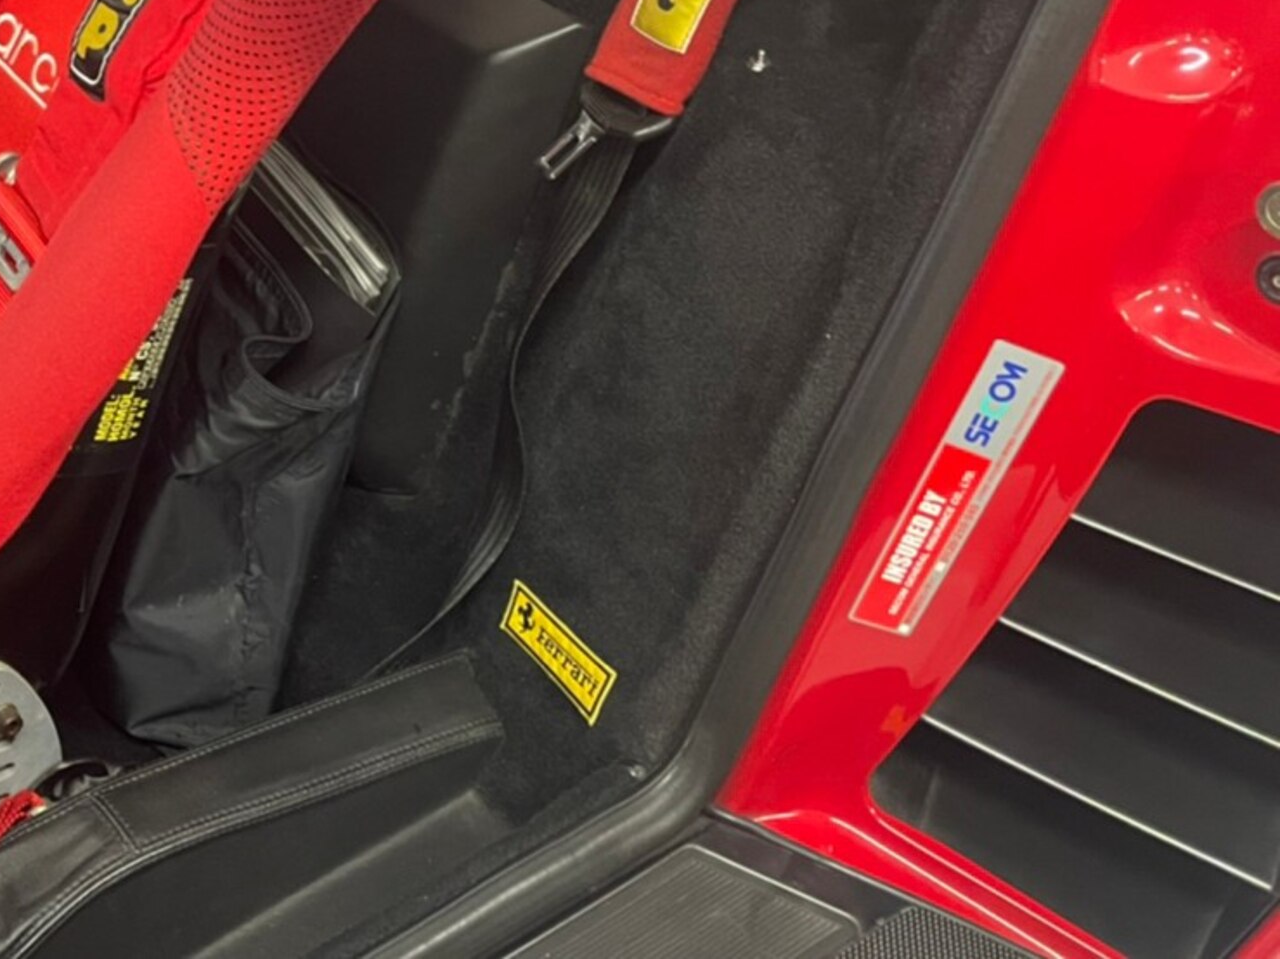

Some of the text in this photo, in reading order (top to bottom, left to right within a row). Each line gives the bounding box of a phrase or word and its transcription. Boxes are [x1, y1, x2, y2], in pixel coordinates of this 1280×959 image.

[964, 360, 1029, 447] SECOM
[881, 514, 935, 584] INSURED
[918, 489, 948, 518] BY
[535, 626, 600, 698] Ferrari
